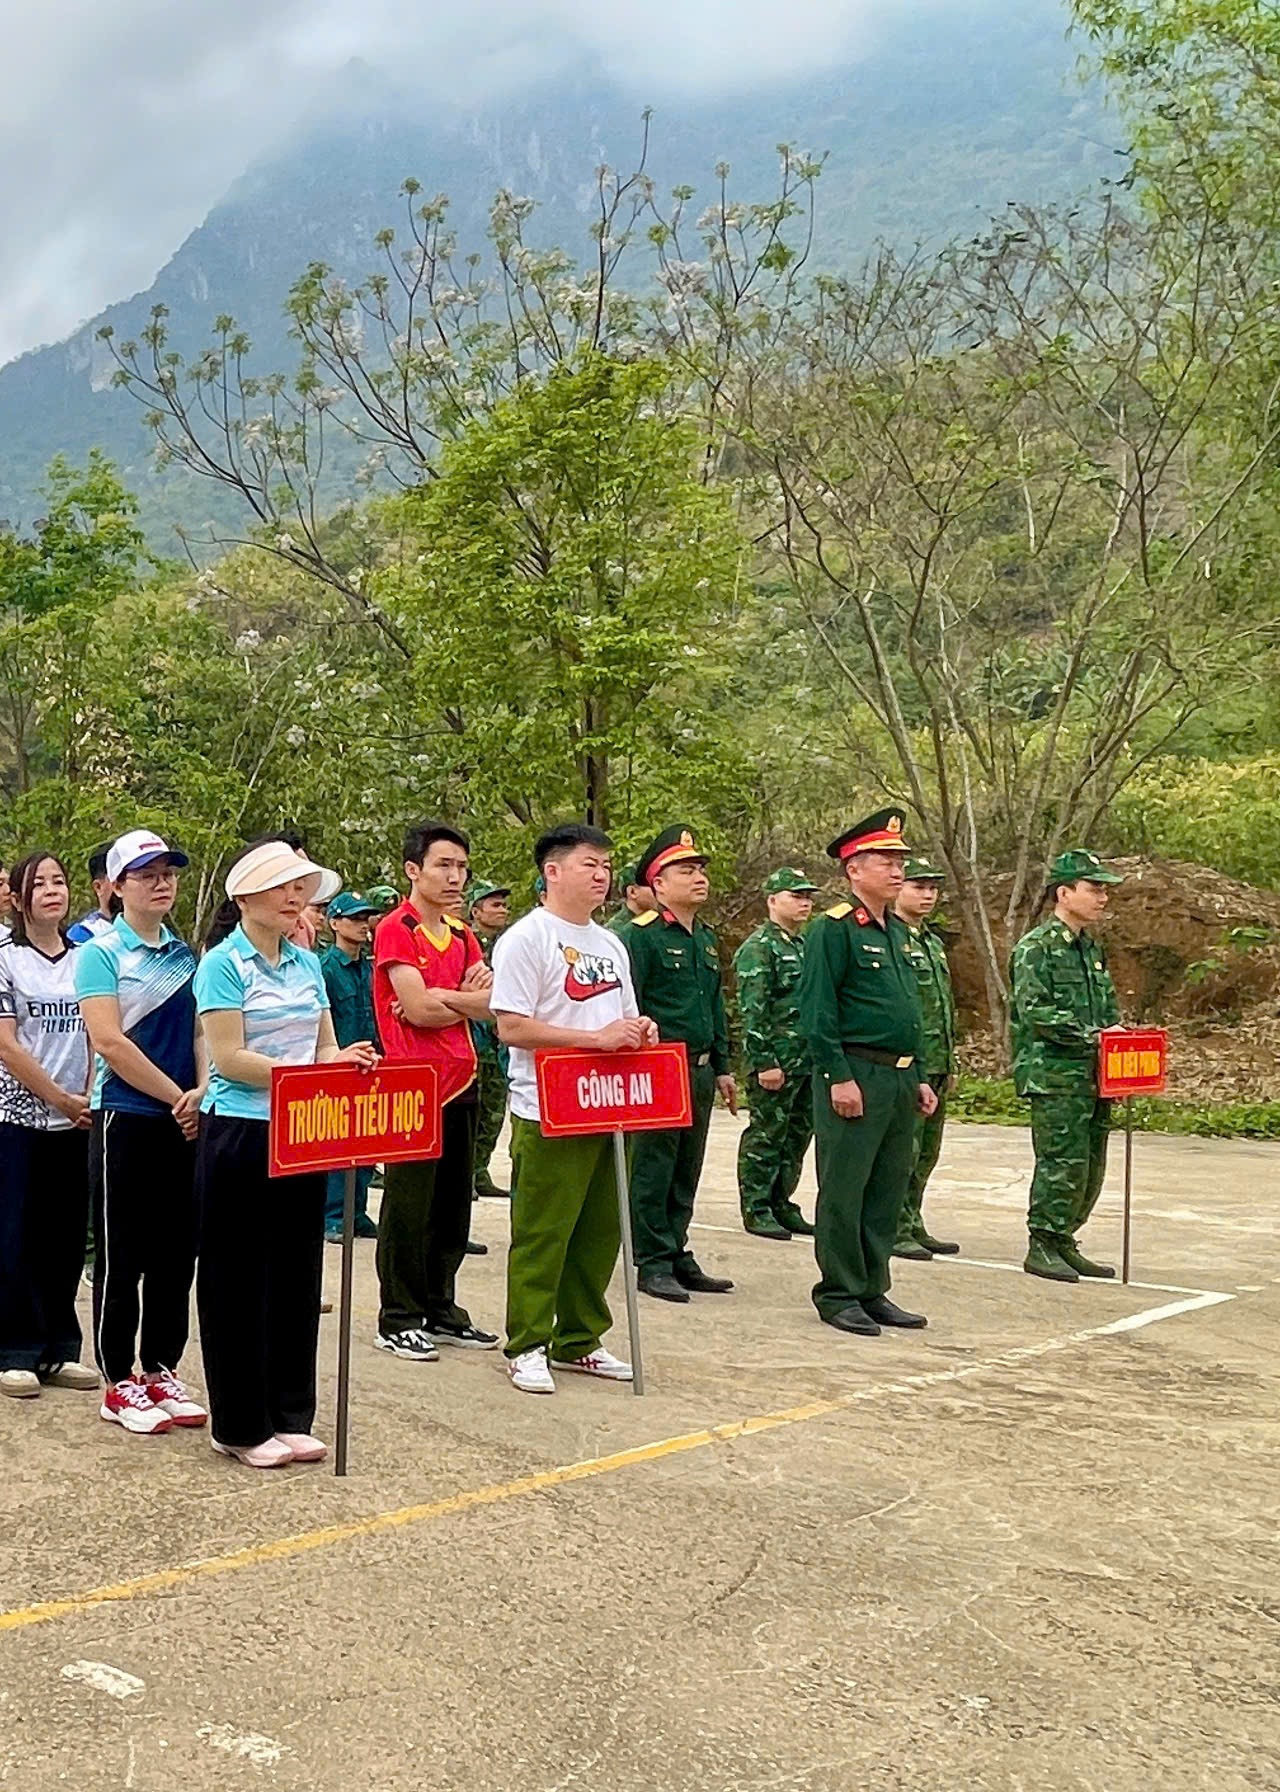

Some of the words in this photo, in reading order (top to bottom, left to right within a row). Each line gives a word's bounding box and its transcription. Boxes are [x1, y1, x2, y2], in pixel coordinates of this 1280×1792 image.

[572, 953, 618, 986] NIKE
[577, 1069, 626, 1109] CÔNG
[629, 1072, 653, 1105] AN
[288, 1089, 350, 1145] TRƯỜNG
[354, 1077, 389, 1137] TIỂU
[392, 1089, 425, 1141] HỌC
